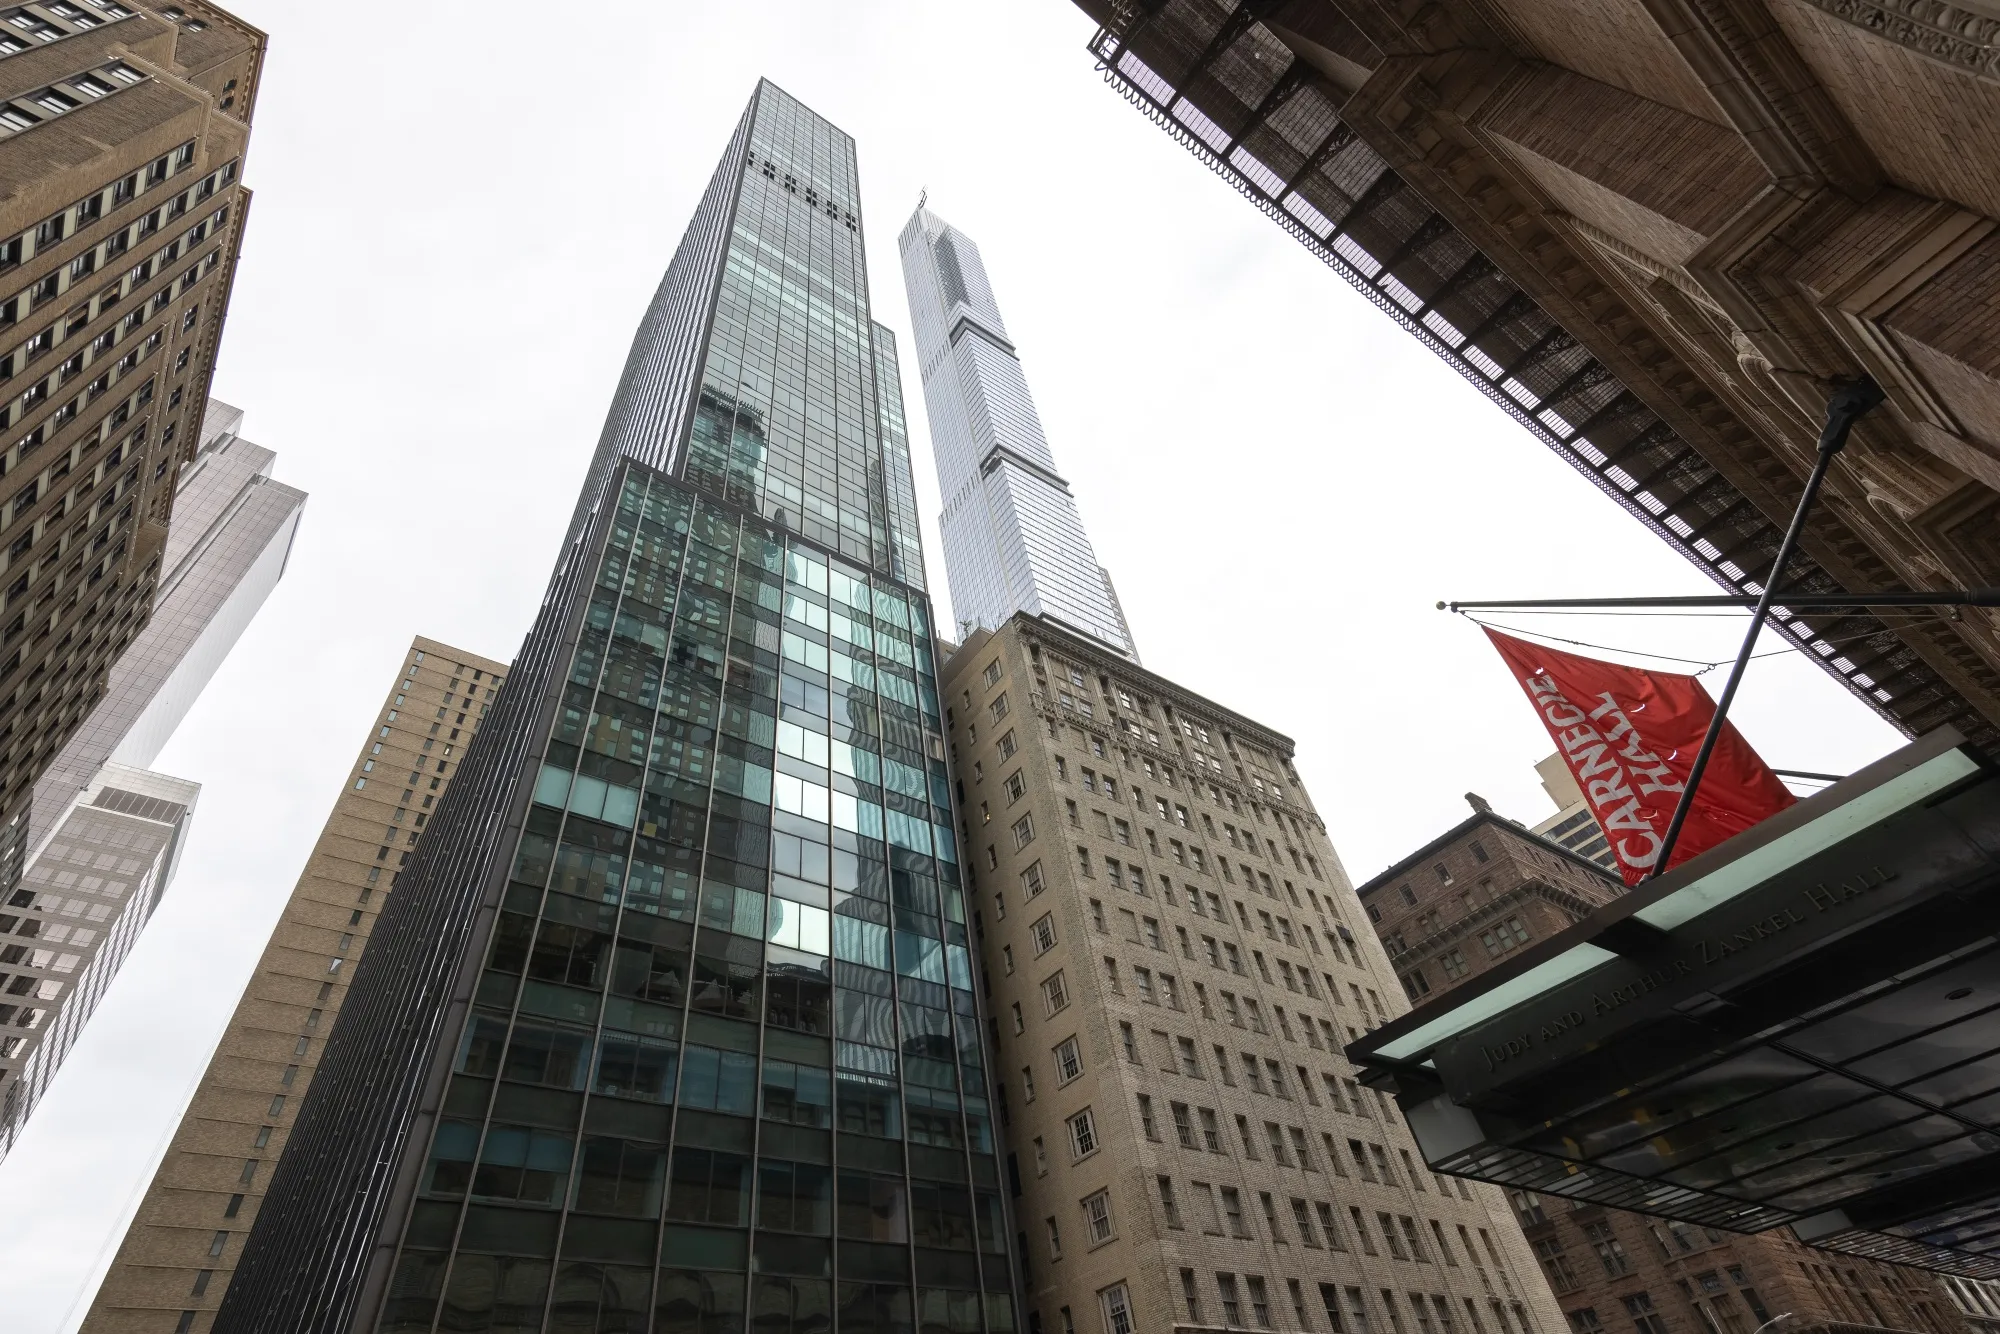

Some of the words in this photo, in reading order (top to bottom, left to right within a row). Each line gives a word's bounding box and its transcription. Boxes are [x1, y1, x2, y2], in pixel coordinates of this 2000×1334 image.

[1526, 674, 1665, 869] CARNEGIE
[1589, 691, 1685, 798] HALL
[1481, 1033, 1532, 1072] JUDY
[1540, 1010, 1584, 1041] AND
[1591, 959, 1693, 1017] ARTHUR
[1693, 908, 1805, 965] ZANKEL
[1803, 865, 1898, 912] HALL
